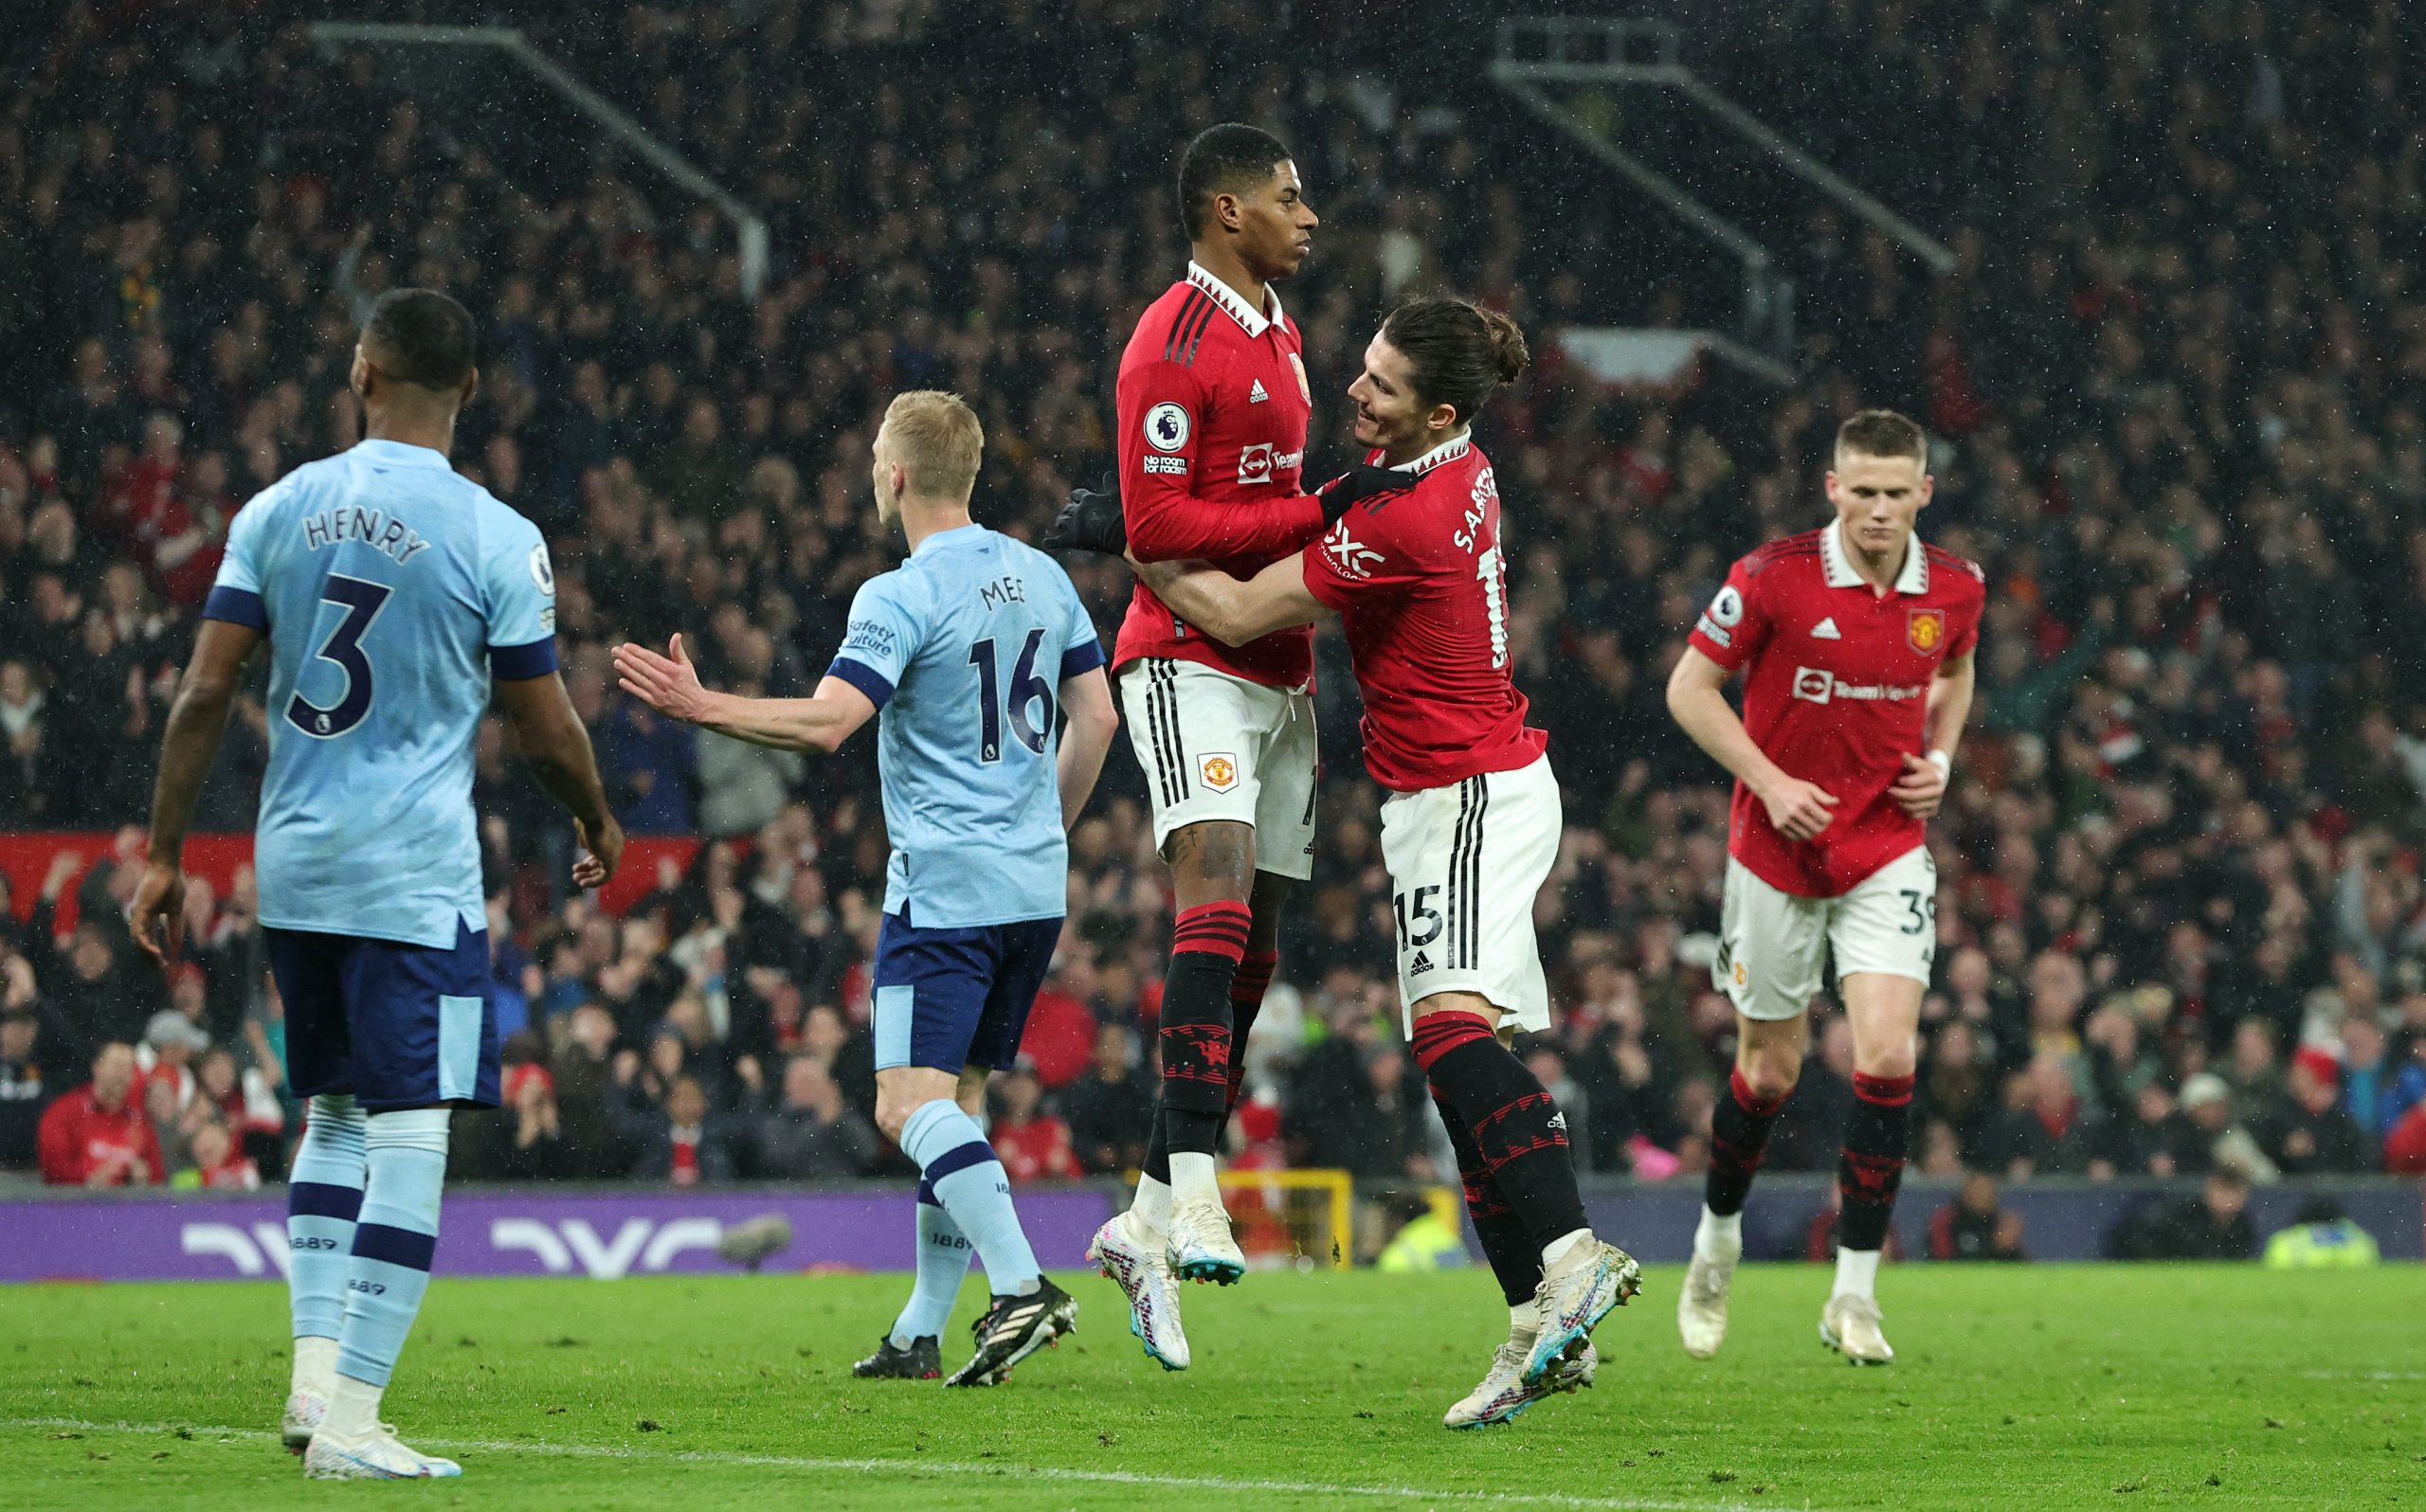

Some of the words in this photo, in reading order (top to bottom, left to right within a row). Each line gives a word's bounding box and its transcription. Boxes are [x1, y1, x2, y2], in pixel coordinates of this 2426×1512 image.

[1144, 455, 1160, 465] No
[1161, 456, 1186, 467] room
[1160, 465, 1187, 476] racism
[302, 505, 432, 567] HENRY
[978, 575, 1026, 612] MEE
[848, 633, 892, 656] ulture
[849, 620, 896, 643] safety
[283, 571, 395, 740] 3
[967, 627, 1057, 765] 16
[1394, 885, 1443, 953] 15
[1410, 963, 1435, 978] adidas
